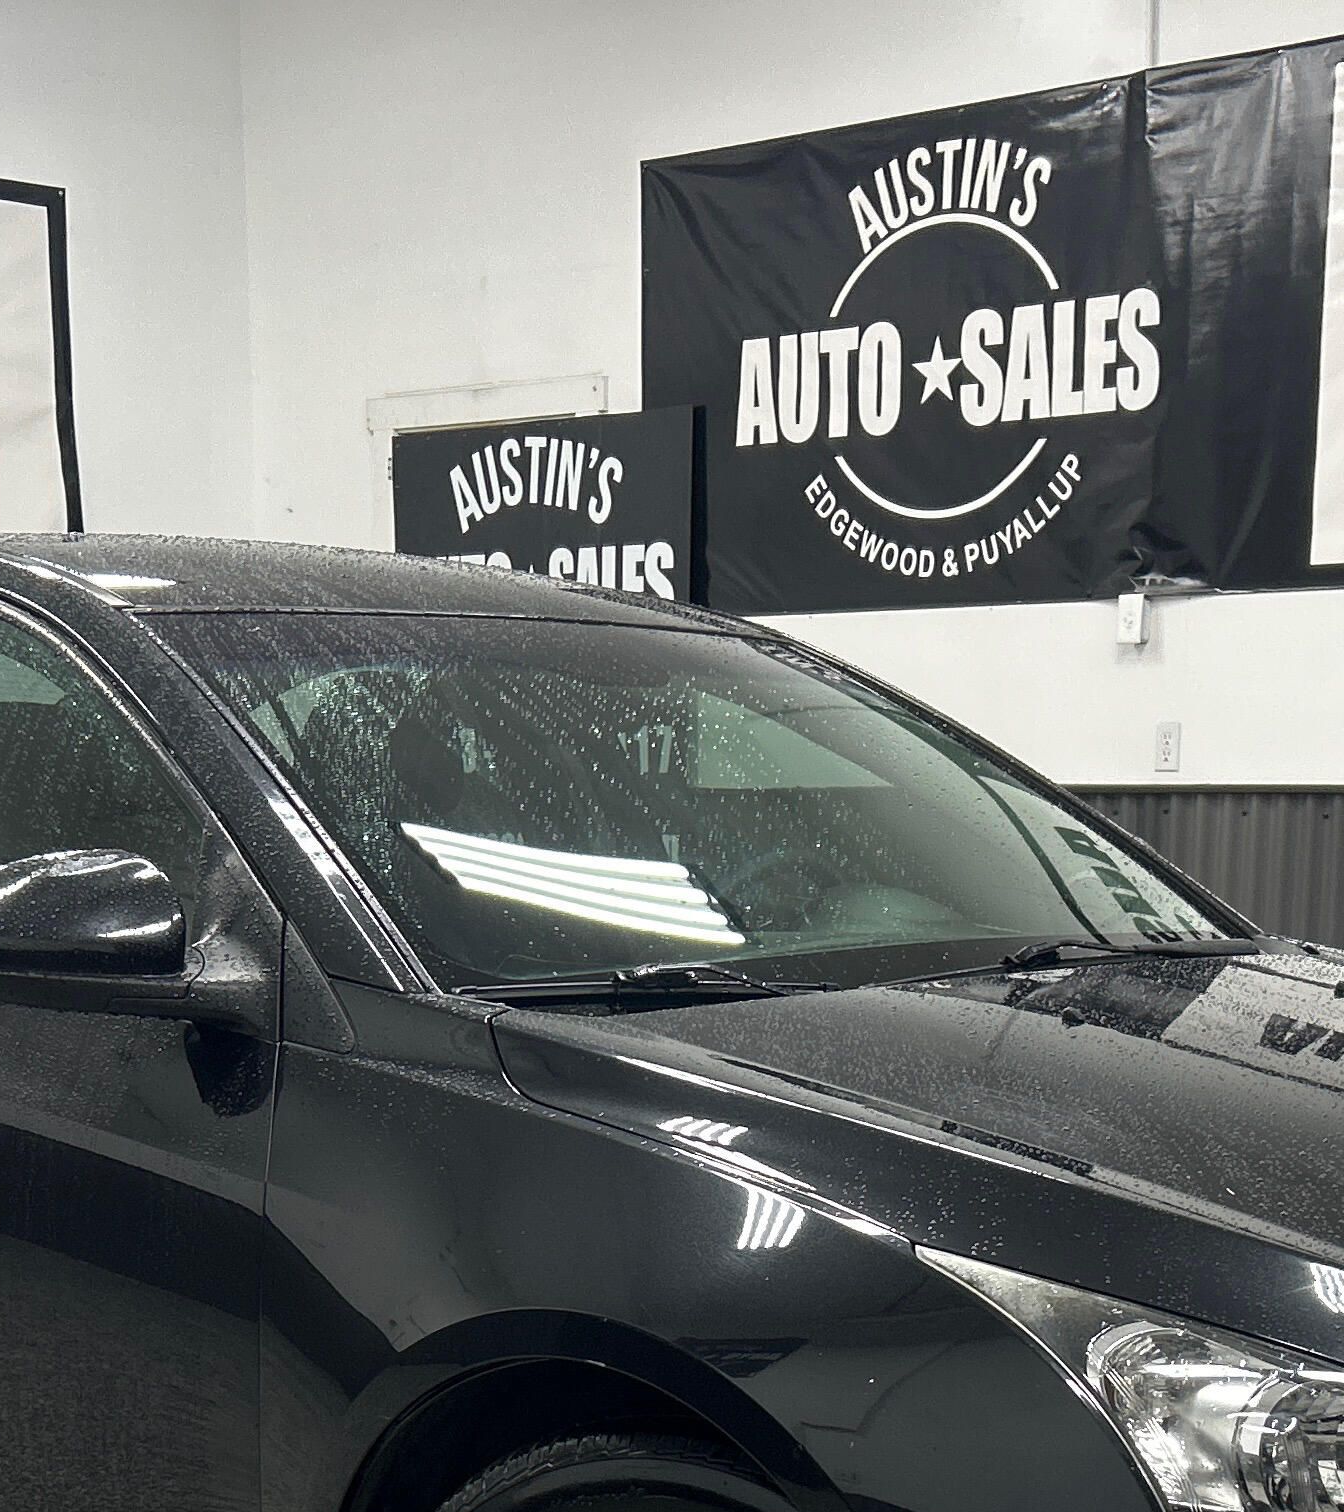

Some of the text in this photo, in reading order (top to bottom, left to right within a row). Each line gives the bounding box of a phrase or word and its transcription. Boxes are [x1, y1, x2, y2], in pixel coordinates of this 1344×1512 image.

[848, 138, 1051, 254] AUSTIN'S
[736, 288, 1161, 447] AUTO SALES
[449, 436, 624, 534] AUSTIN'S
[804, 453, 1082, 579] EDGEWOOD & PUYALLUP
